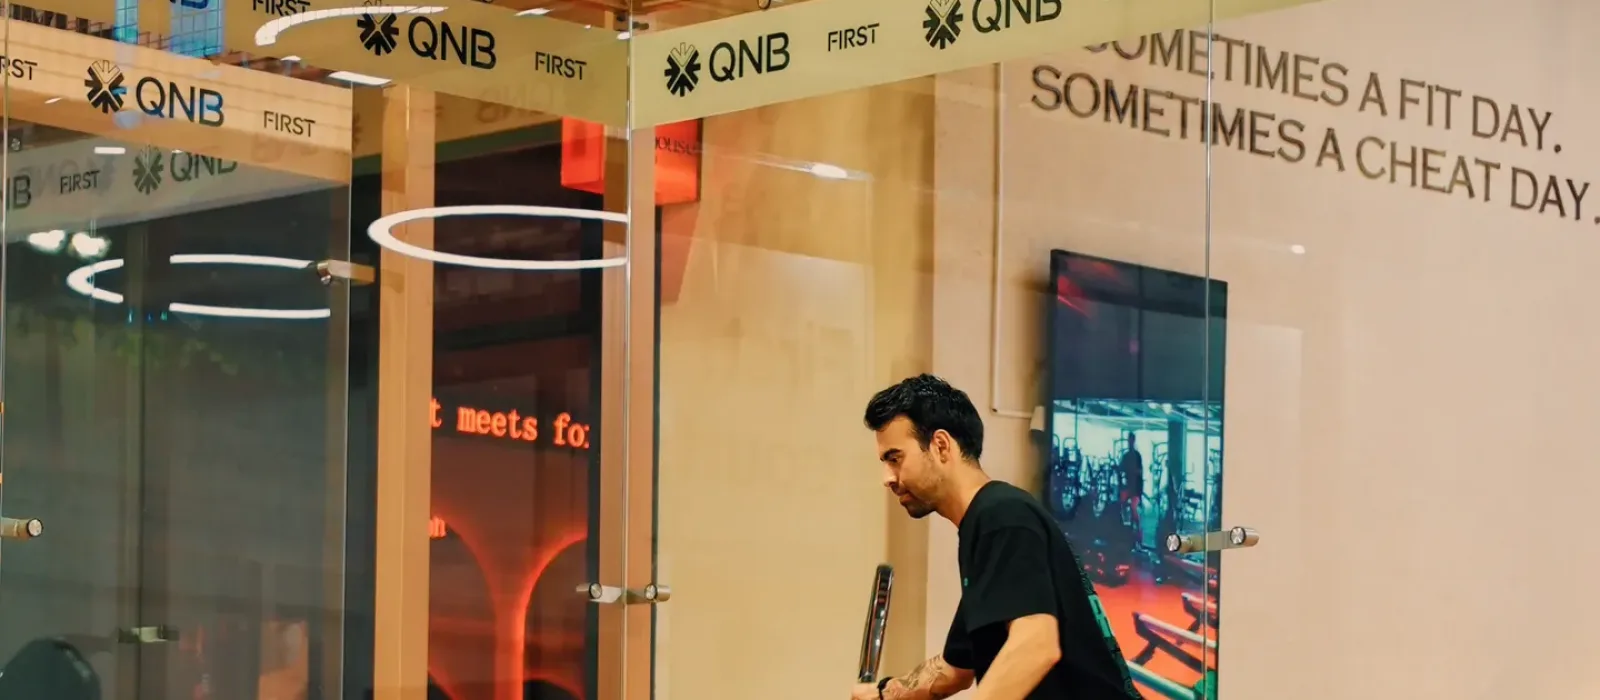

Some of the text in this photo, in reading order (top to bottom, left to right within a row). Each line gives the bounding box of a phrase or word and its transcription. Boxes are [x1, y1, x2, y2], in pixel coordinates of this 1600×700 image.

[408, 15, 587, 80] QNB FIRST
[708, 31, 791, 82] QNB
[828, 23, 880, 52] FIRST
[135, 76, 316, 138] QNB FIRST
[1084, 28, 1563, 154] OMETIMES A FIT DAY.
[1031, 65, 1600, 225] SOMETIMES A CHEAT DAY.
[59, 169, 101, 195] FIRST
[457, 406, 538, 441] meets
[552, 411, 590, 449] fo
